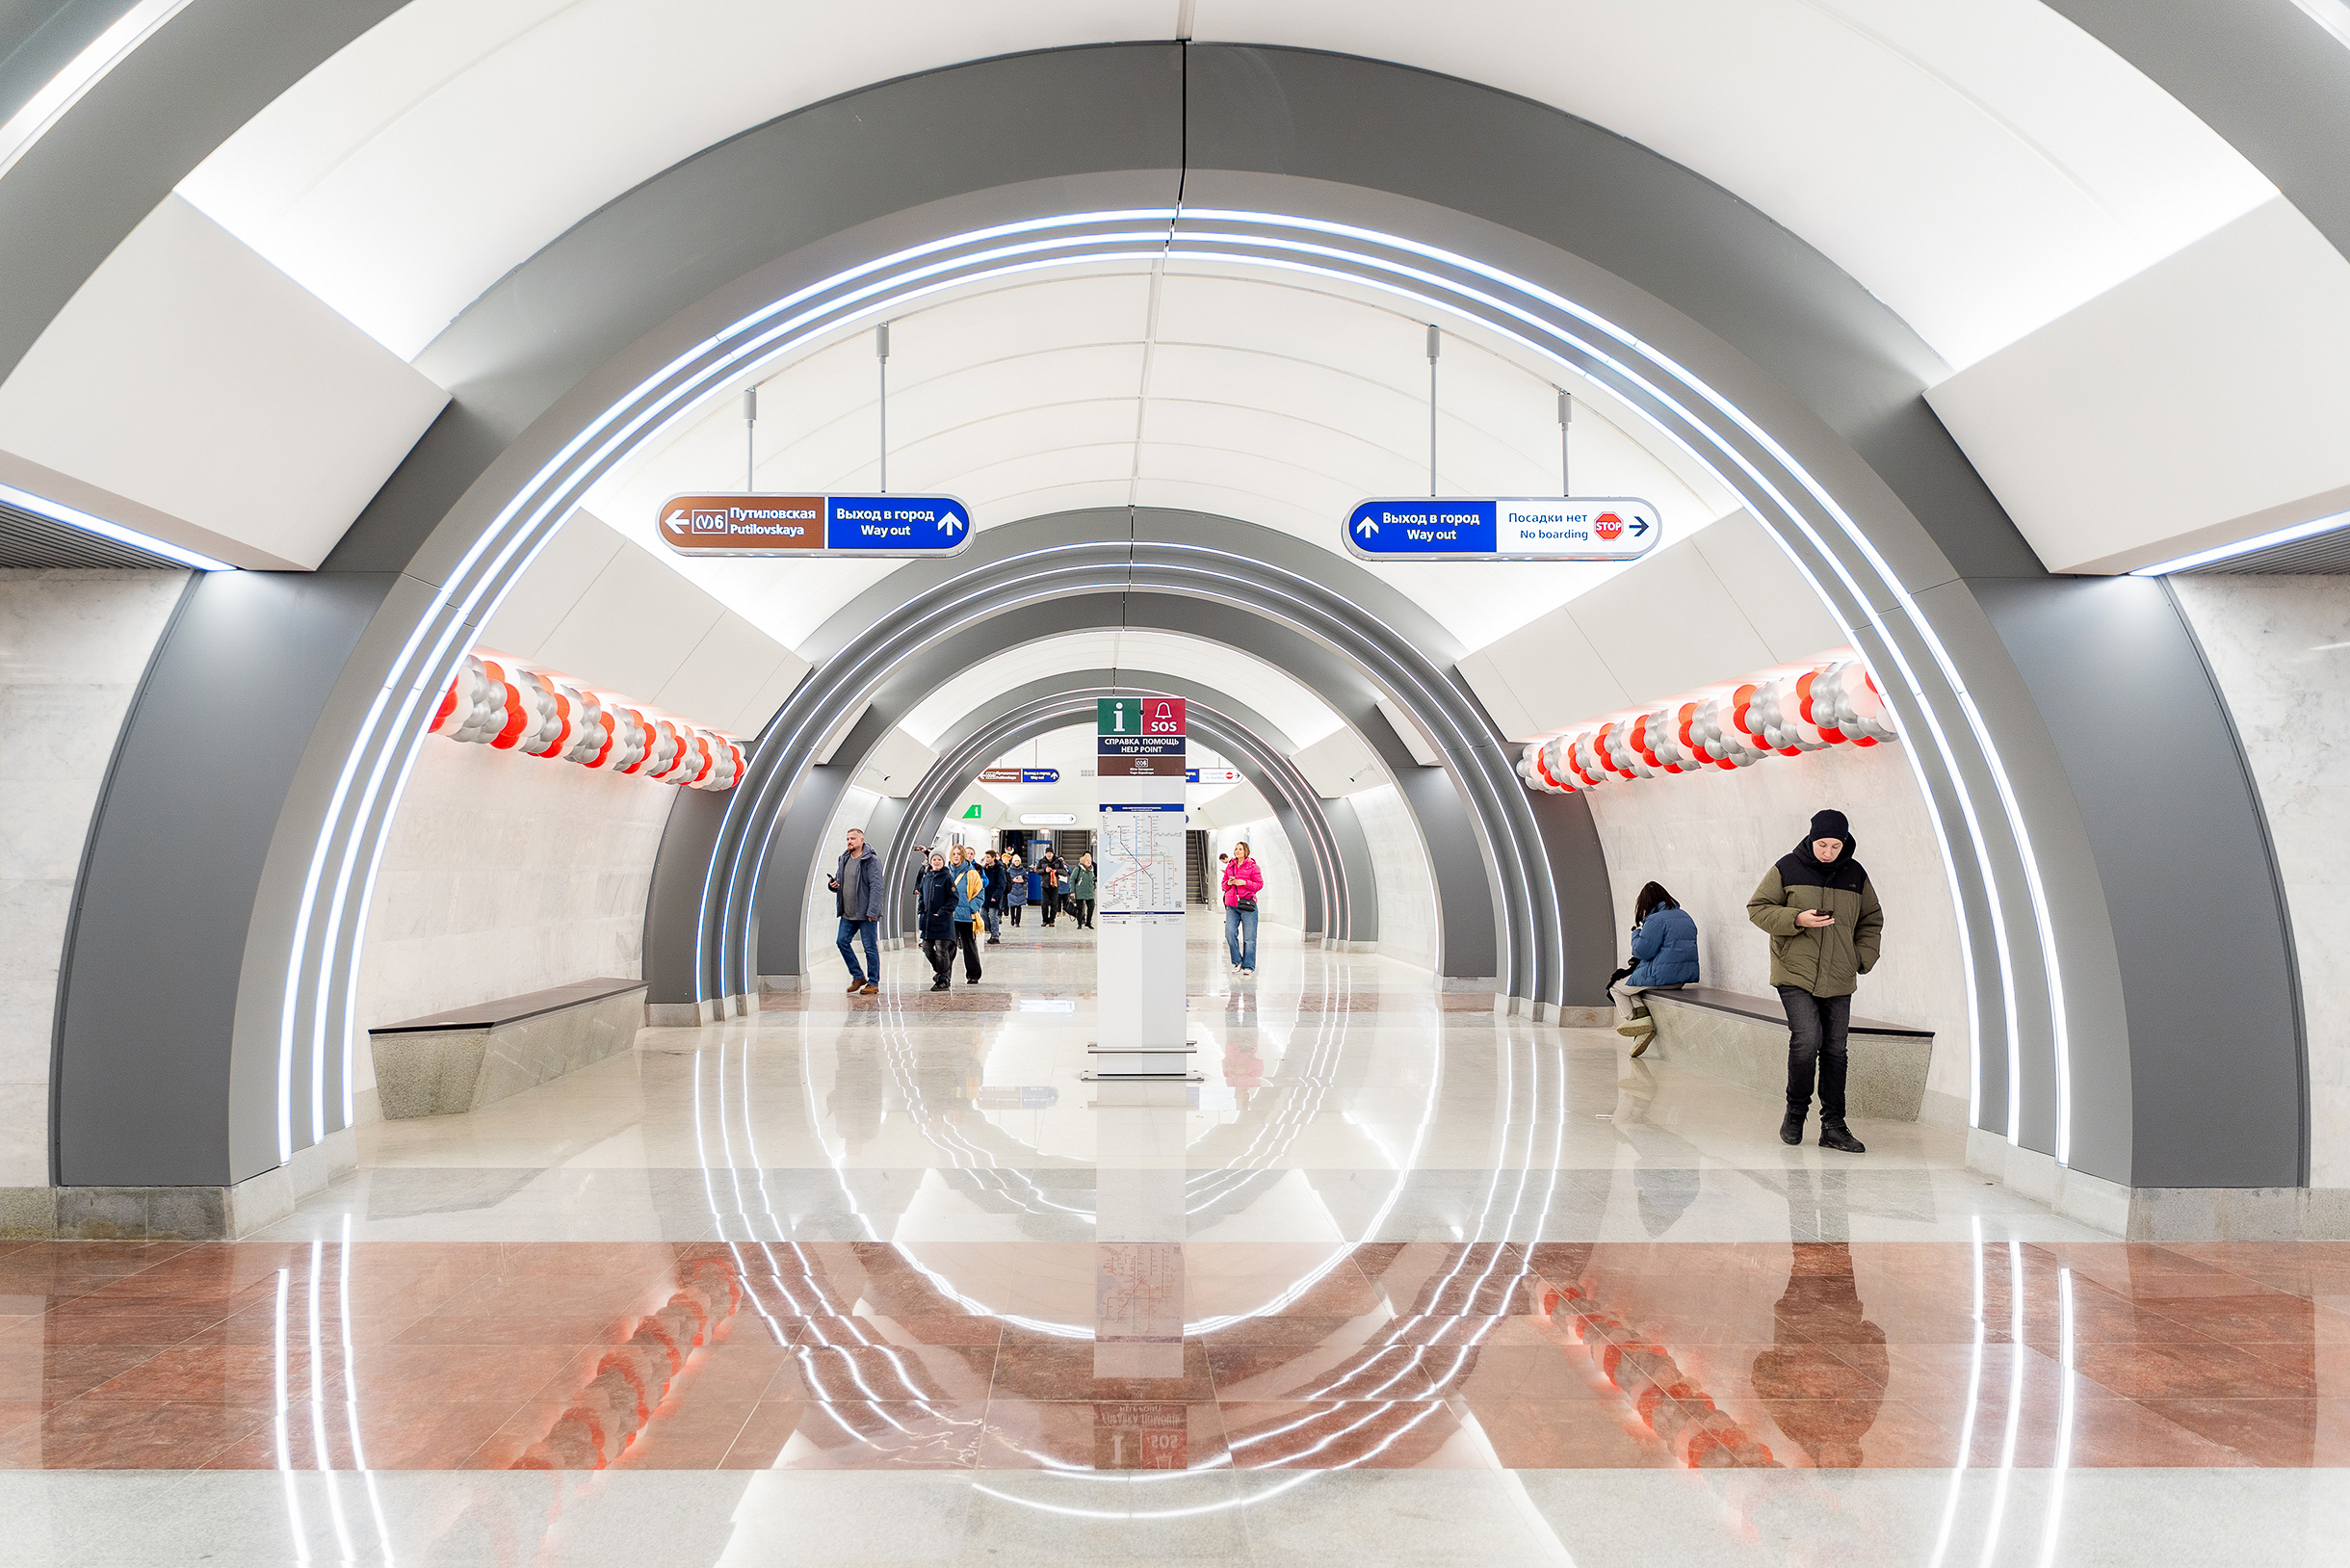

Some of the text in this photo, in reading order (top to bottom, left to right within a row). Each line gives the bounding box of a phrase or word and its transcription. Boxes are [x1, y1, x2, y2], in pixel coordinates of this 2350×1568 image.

[729, 507, 816, 521] Путиловская
[836, 508, 935, 523] Выход в город
[1382, 511, 1480, 527] Выход в город
[1508, 512, 1563, 524] Посадки
[729, 524, 805, 537] Putilovskaya
[860, 525, 911, 537] Way out
[1595, 521, 1623, 532] STOP
[1406, 529, 1457, 542] Way out
[1520, 529, 1588, 541] No boarding
[1150, 721, 1177, 732] SOS
[1142, 738, 1180, 746] ПОМОЩЬ
